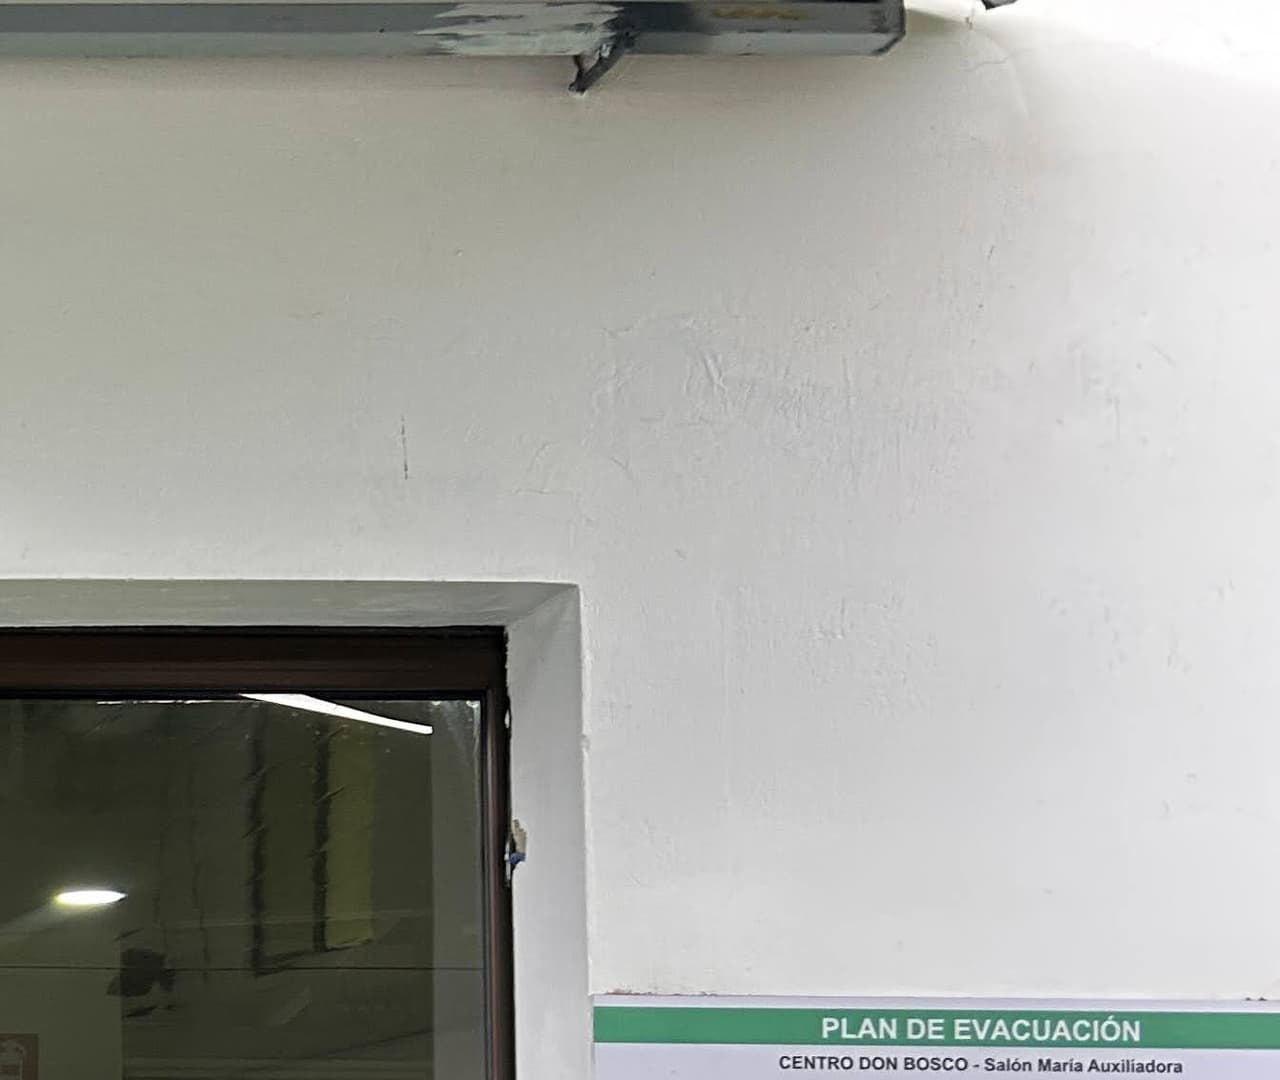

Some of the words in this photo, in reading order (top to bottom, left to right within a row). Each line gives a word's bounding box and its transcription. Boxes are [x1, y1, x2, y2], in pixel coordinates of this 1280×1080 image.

[822, 1017, 897, 1040] PLAN
[907, 1018, 945, 1040] DE
[954, 1016, 1140, 1042] EVACUACIÓN
[779, 1055, 854, 1071] CENTRO
[859, 1056, 898, 1071] DON
[903, 1056, 969, 1072] BOSCO
[984, 1057, 1032, 1072] Salón
[1038, 1058, 1083, 1073] María
